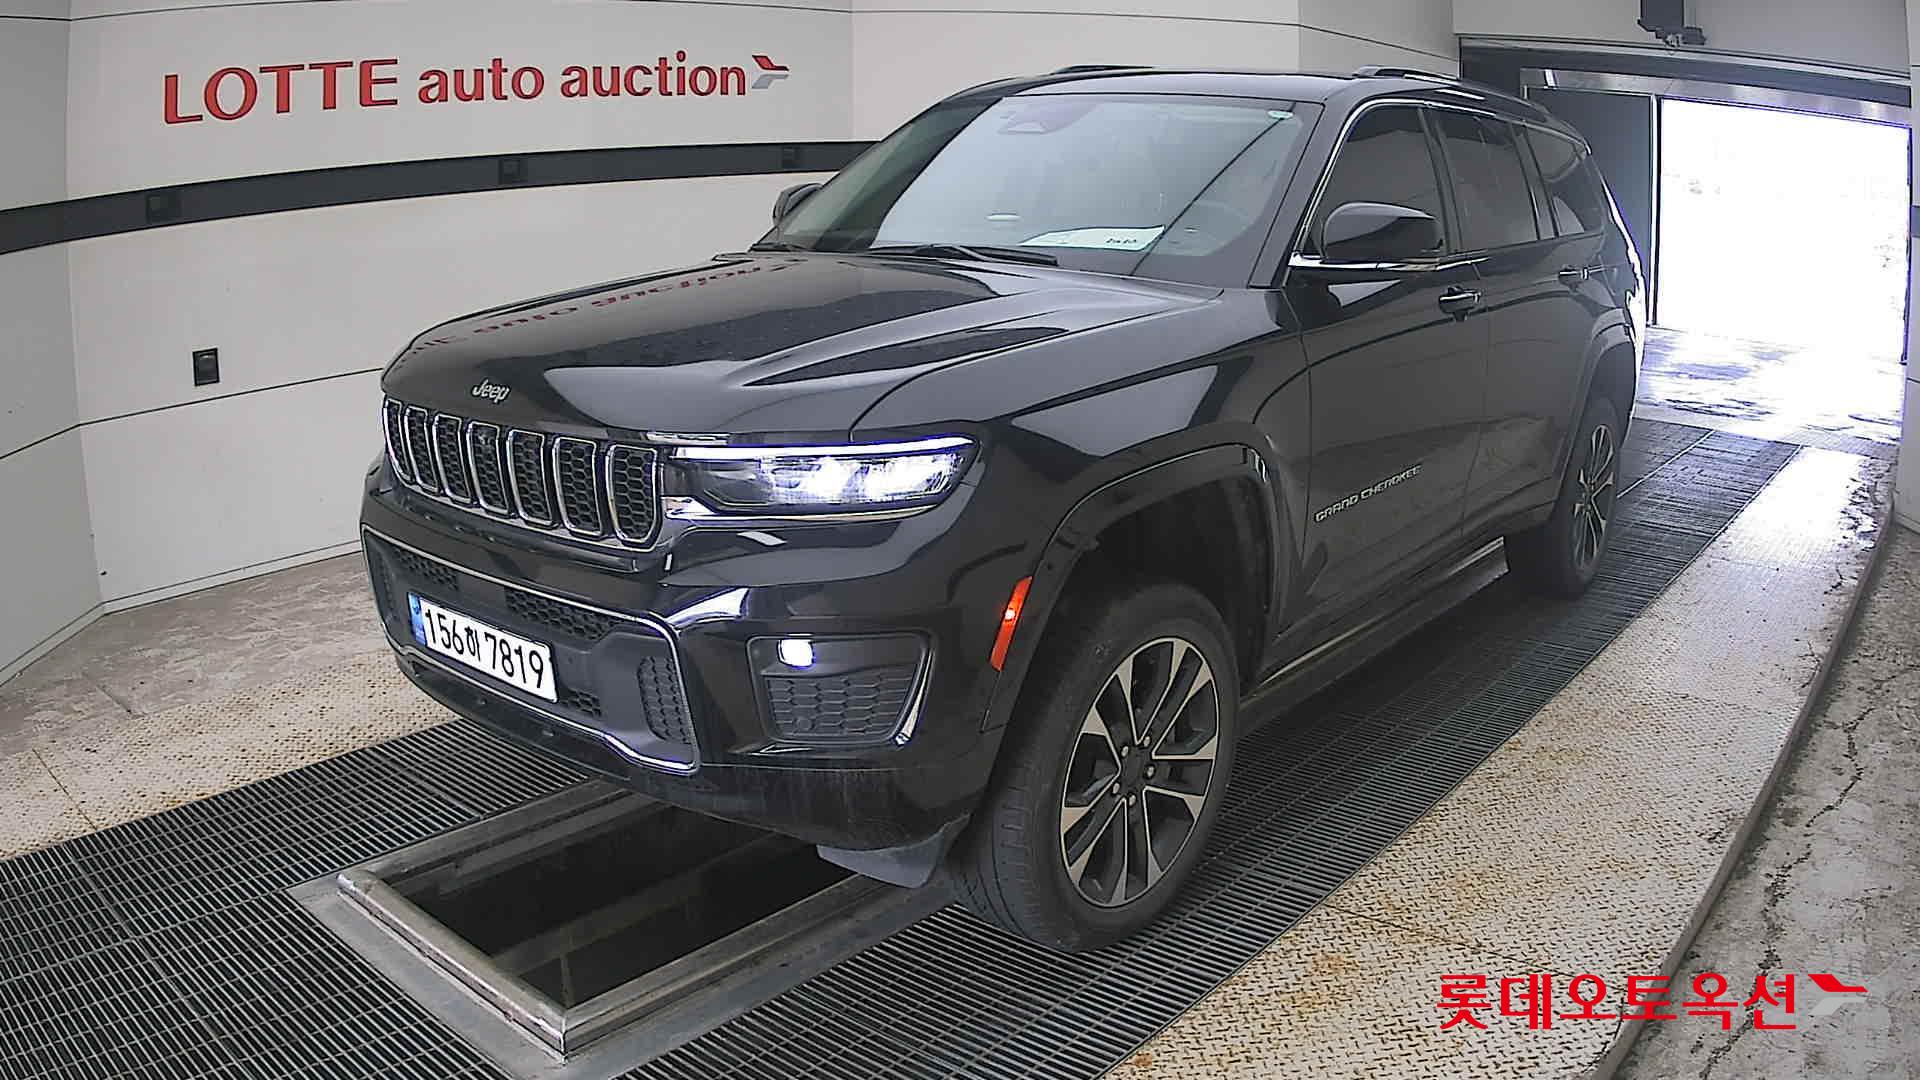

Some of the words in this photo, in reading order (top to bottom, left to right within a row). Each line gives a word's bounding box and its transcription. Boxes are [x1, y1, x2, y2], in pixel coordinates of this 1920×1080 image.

[164, 58, 398, 125] LOTTE
[418, 57, 546, 104] auto
[560, 49, 747, 98] auction
[471, 378, 510, 404] Jeep
[1314, 494, 1359, 522] GRAND
